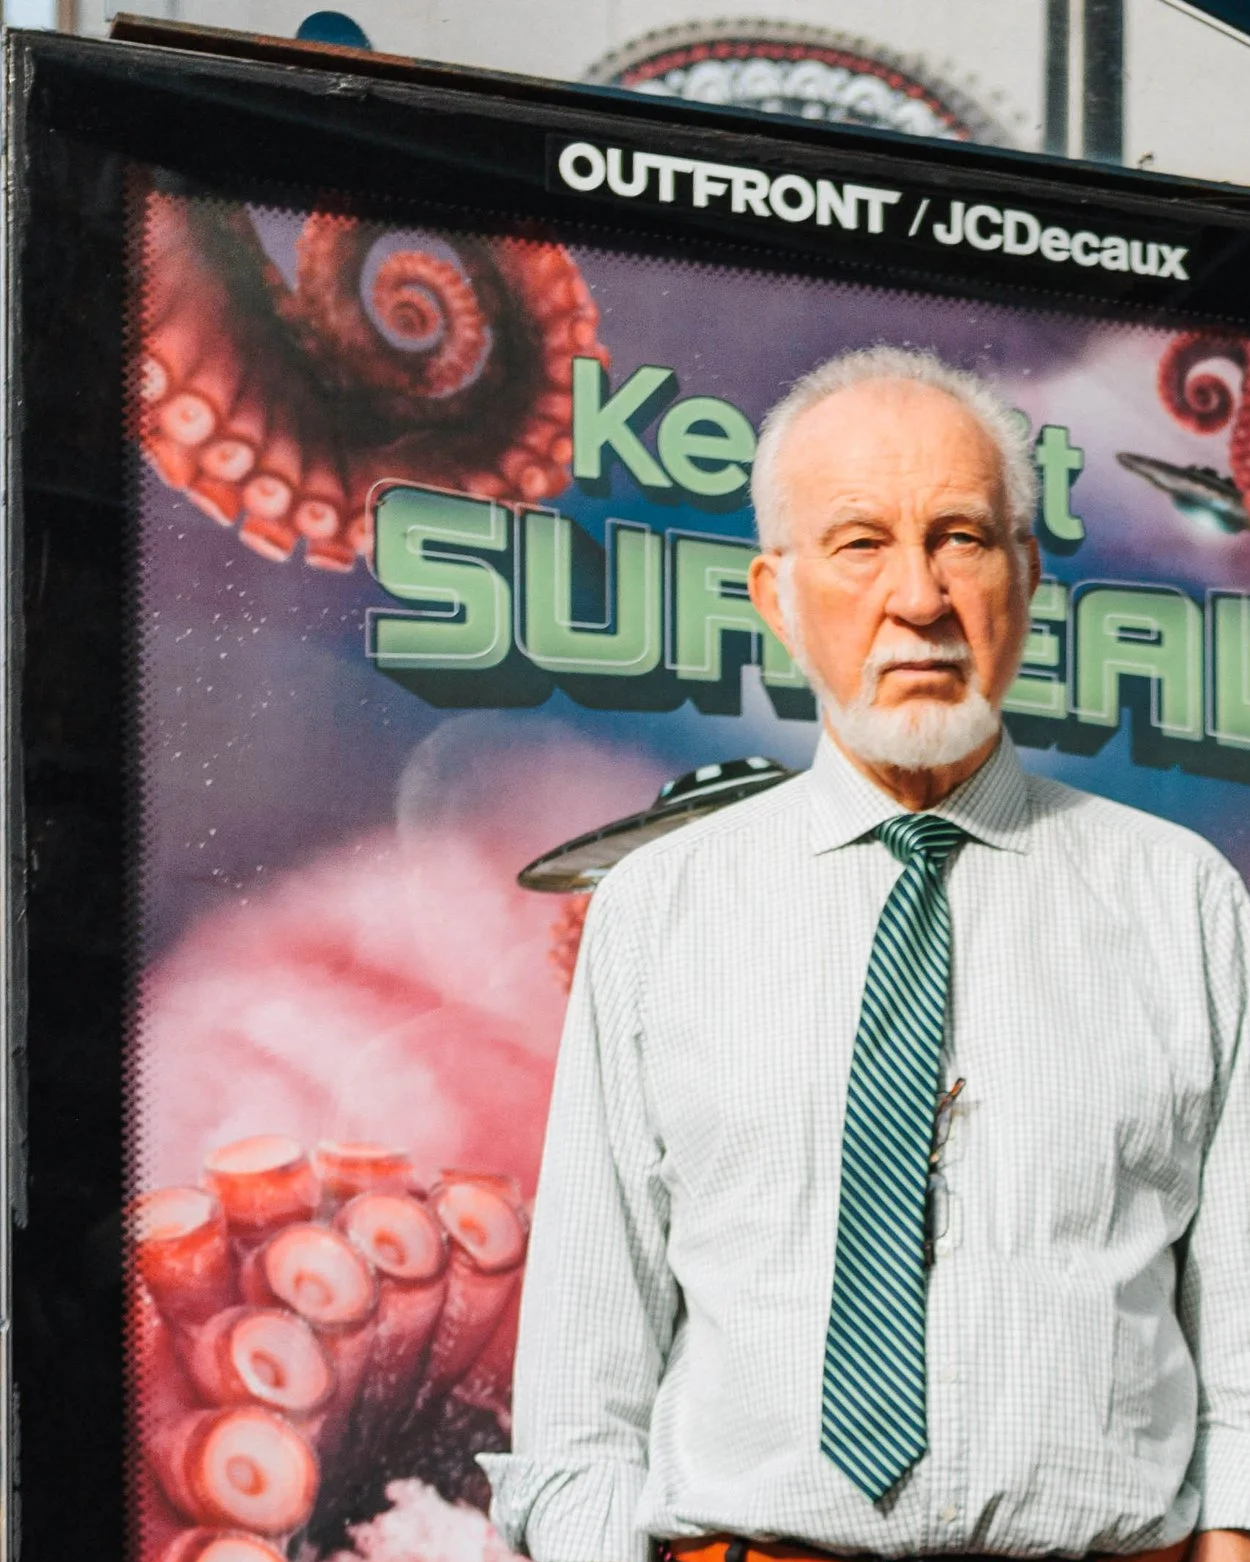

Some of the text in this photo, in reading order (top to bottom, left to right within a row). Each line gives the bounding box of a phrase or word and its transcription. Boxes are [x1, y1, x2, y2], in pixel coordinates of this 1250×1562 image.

[558, 142, 901, 234] OUTFRONT
[933, 201, 1190, 280] JCDecaux
[572, 356, 758, 497] Ke
